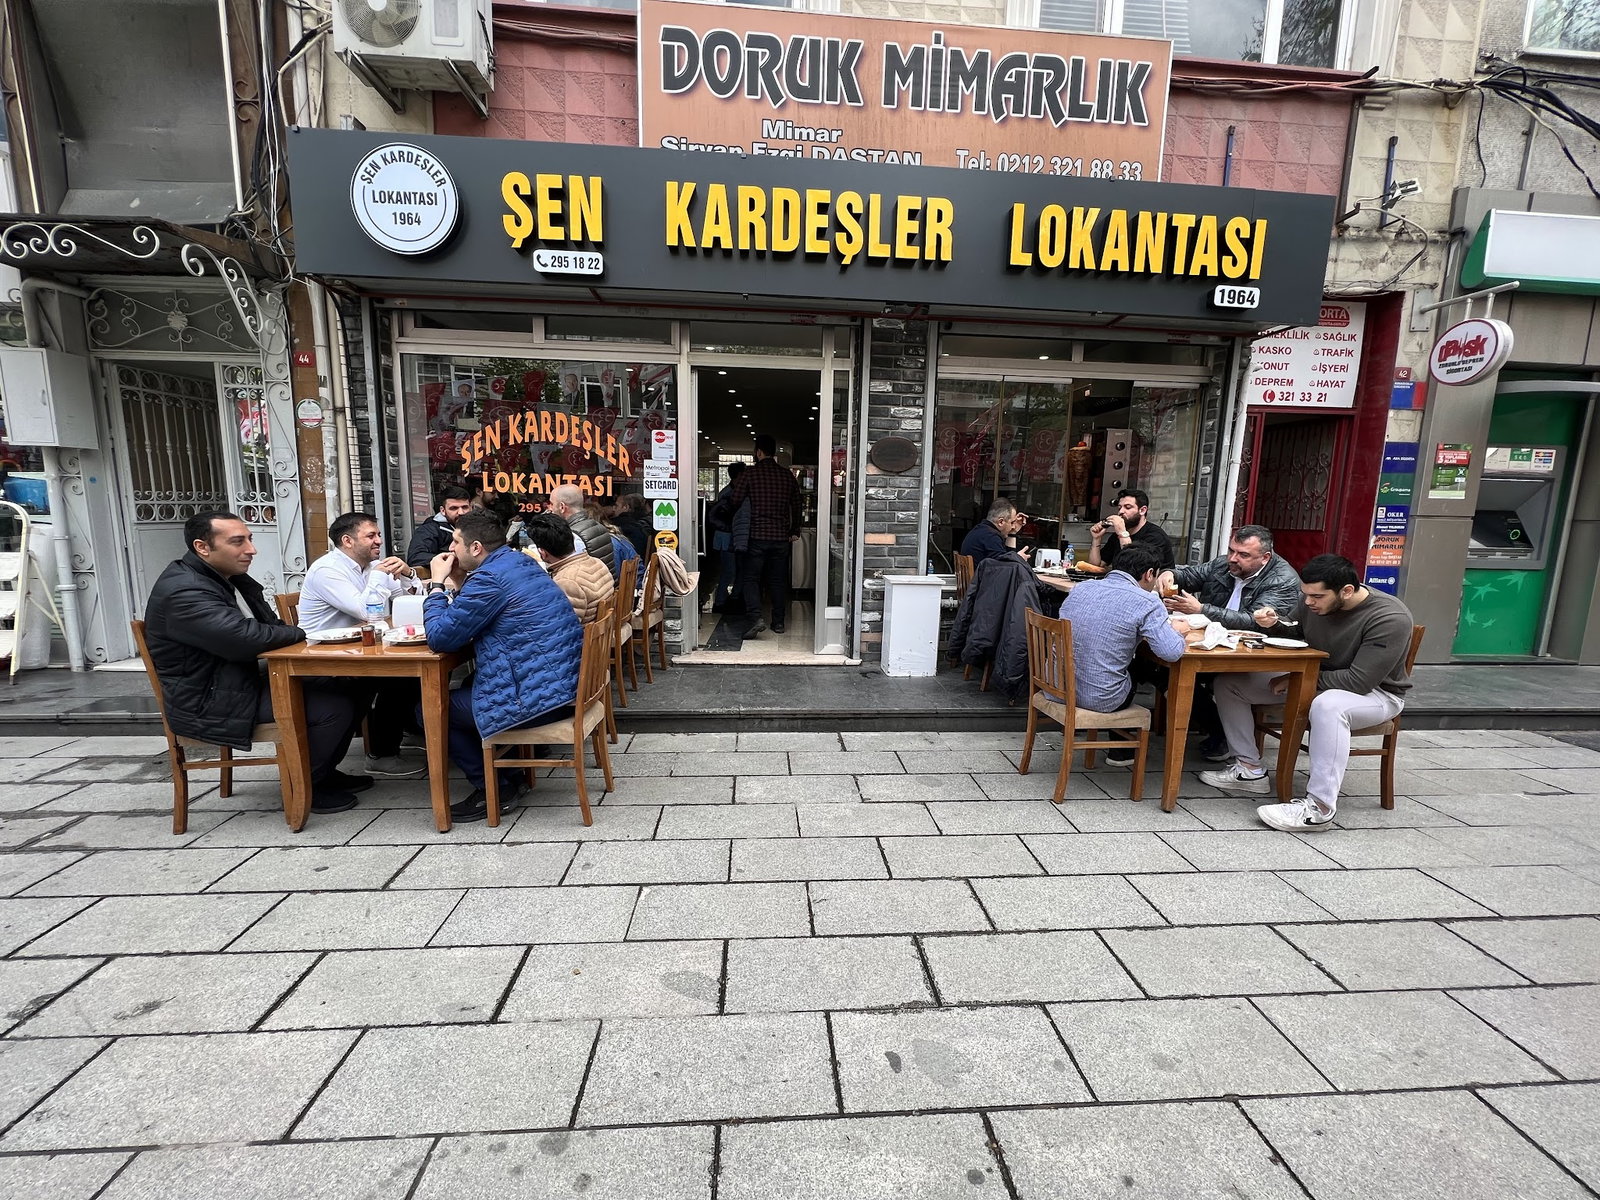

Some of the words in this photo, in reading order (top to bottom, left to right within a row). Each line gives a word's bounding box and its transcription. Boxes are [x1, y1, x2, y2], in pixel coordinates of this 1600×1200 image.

[659, 25, 864, 109] DORUK
[881, 31, 1152, 128] MİMARLIK
[762, 119, 843, 143] Mimar
[360, 160, 381, 184] ŞEN
[380, 150, 447, 188] KARDEŞLER
[997, 153, 1044, 174] 0212
[1050, 156, 1083, 177] 321
[1090, 158, 1114, 179] 88
[1118, 160, 1142, 181] 33
[372, 190, 438, 206] LOKANTASI
[392, 212, 422, 226] 1964
[502, 171, 603, 248] ŞEN
[666, 181, 954, 265] KARDEŞLER
[1010, 202, 1268, 280] LOKANTASI
[551, 255, 569, 268] 295
[573, 257, 584, 269] 18
[588, 257, 600, 270] 22
[1218, 288, 1256, 306] 1964
[1320, 308, 1347, 319] ORTA
[1262, 329, 1310, 340] MEKLİLİK
[1322, 331, 1357, 342] SAĞLIK
[299, 354, 309, 363] 44
[1258, 346, 1292, 355] KASKO
[1321, 348, 1354, 357] TRAFİK
[1318, 362, 1349, 374] İŞYERİ
[1398, 370, 1408, 378] 42
[1254, 377, 1294, 387] DEPREM
[1316, 380, 1346, 388] HAYAT
[1279, 391, 1295, 401] 321
[1300, 392, 1312, 402] 33
[1317, 393, 1327, 403] 21
[461, 420, 500, 477] ŞEN
[508, 410, 632, 477] KARDEŞLER
[482, 471, 612, 497] LOKANTASI
[645, 480, 677, 490] SETCARD
[518, 502, 541, 513] 295
